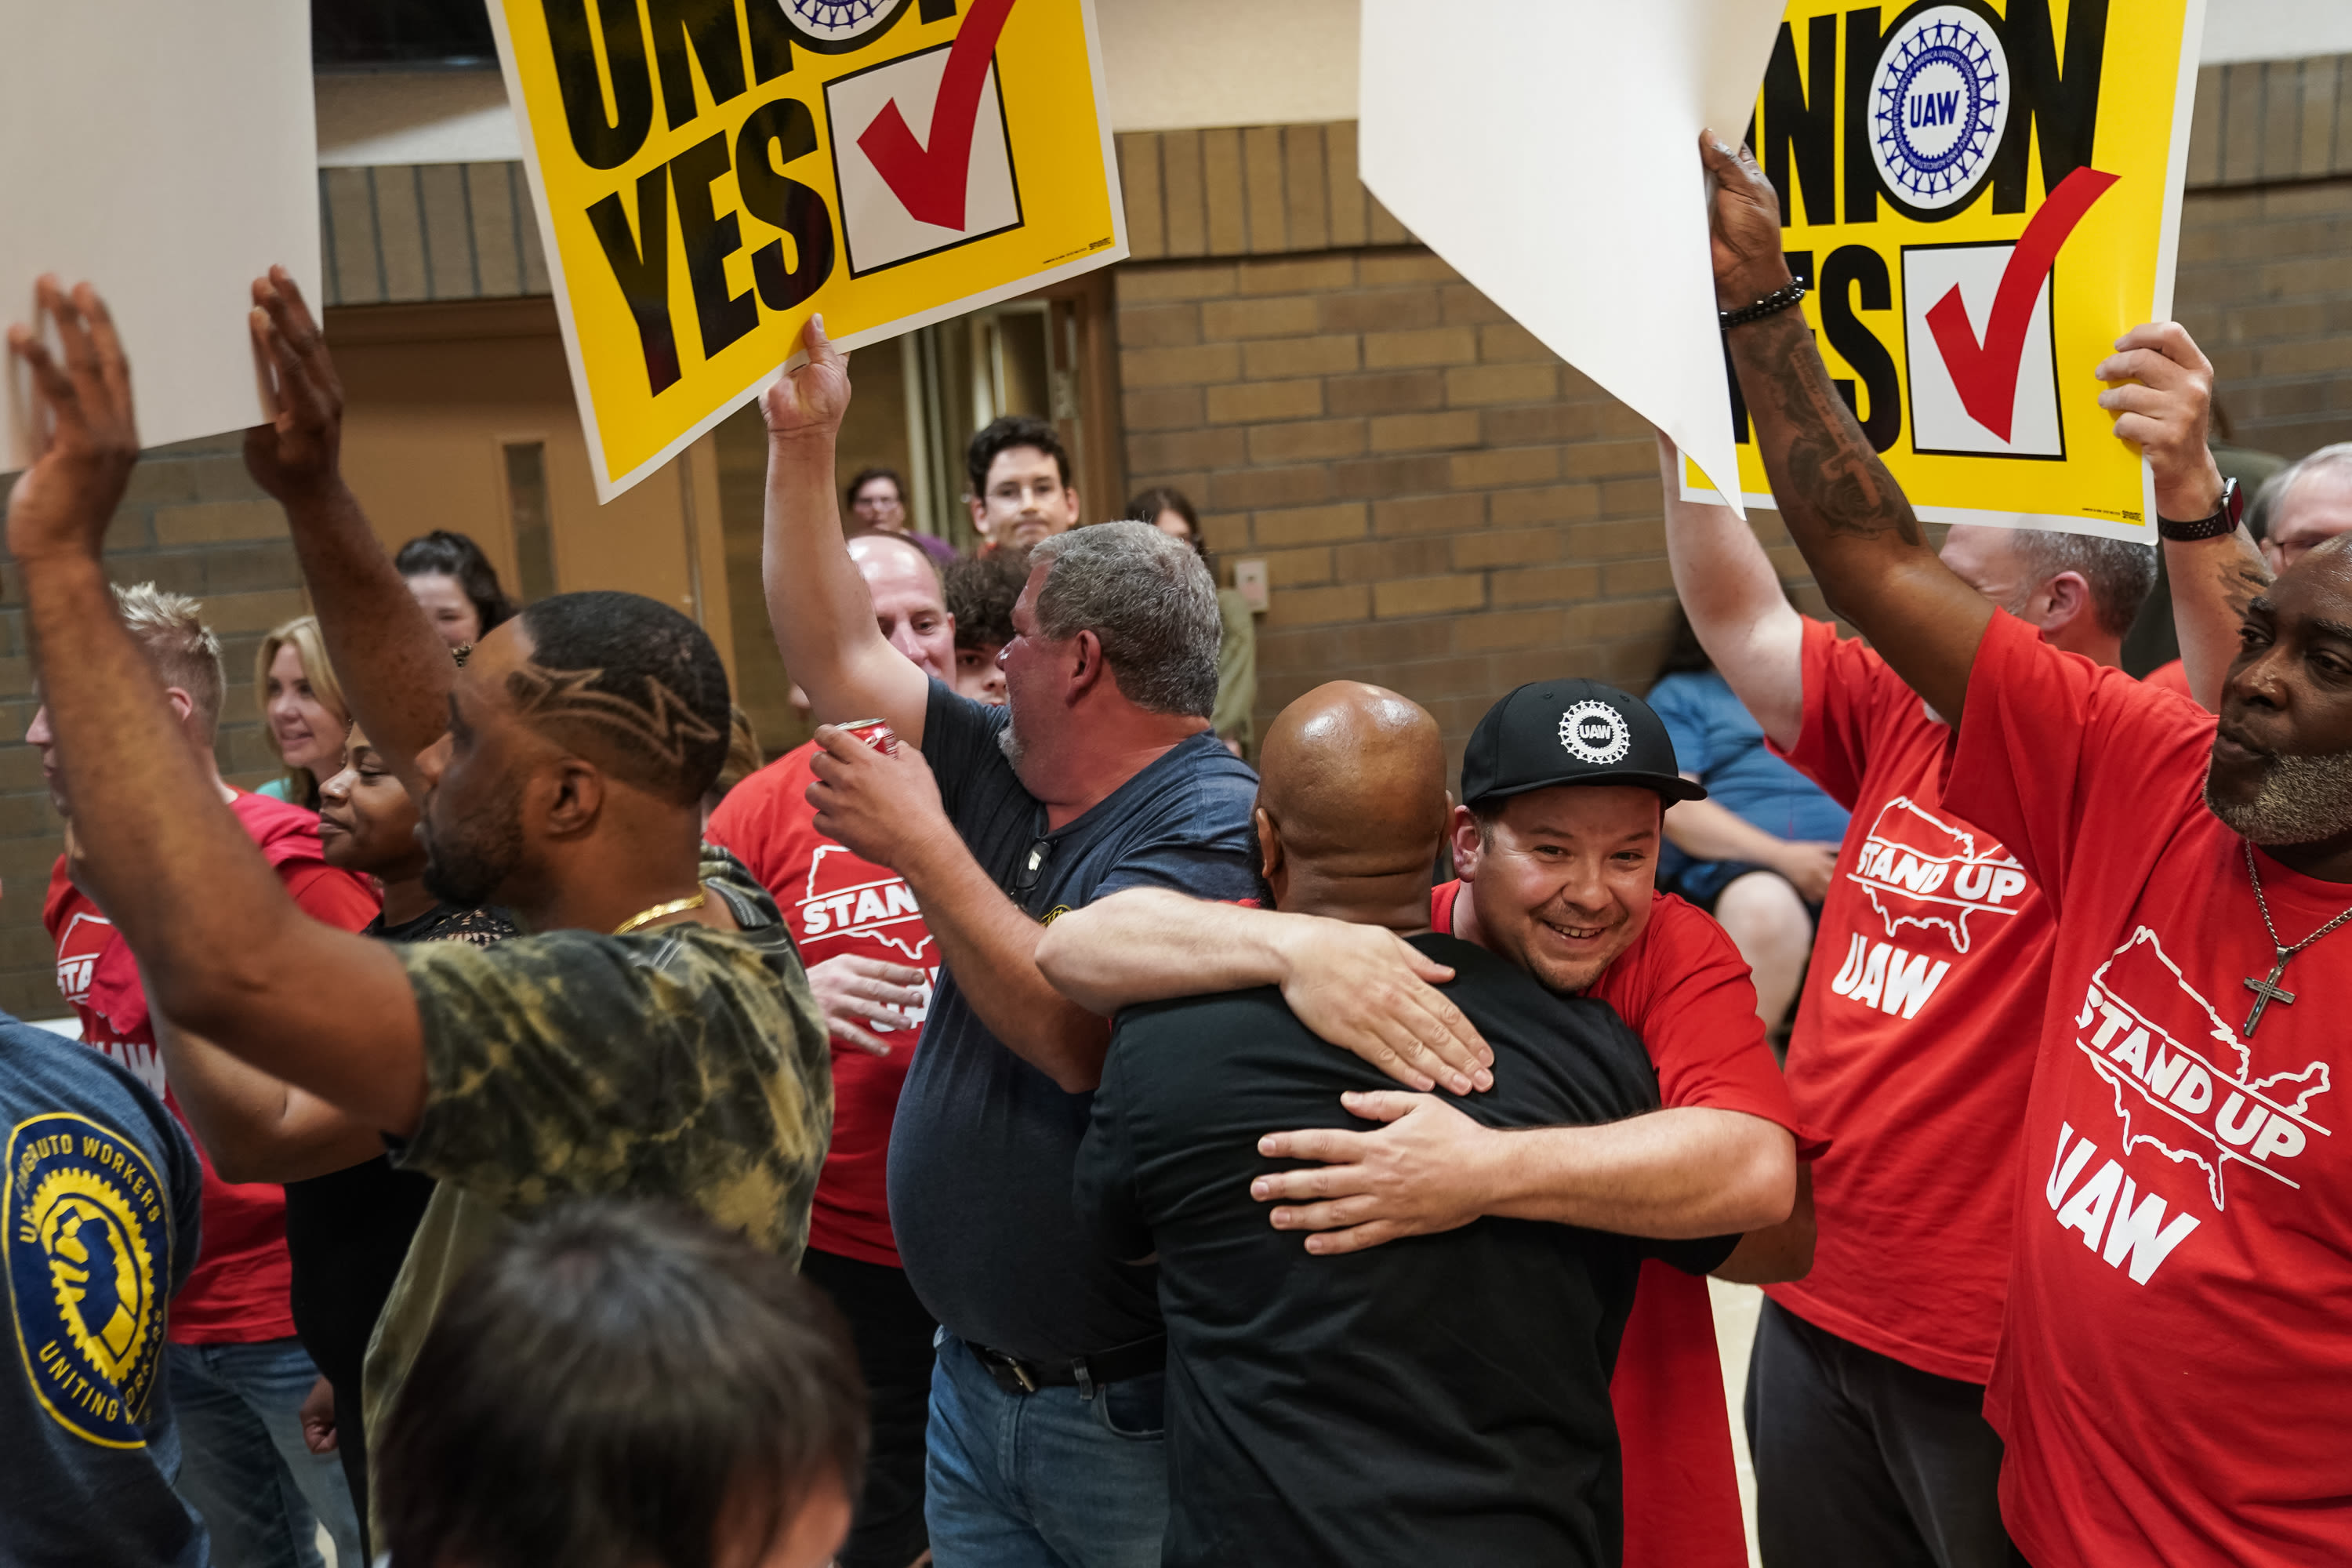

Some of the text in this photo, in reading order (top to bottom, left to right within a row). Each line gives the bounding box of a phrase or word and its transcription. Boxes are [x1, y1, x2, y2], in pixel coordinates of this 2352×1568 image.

[1913, 49, 1938, 70] AMERICA
[1740, 0, 2109, 227] NION
[1911, 90, 1960, 129] UAW
[586, 98, 835, 397] YES
[1579, 724, 1611, 739] UAW
[803, 884, 920, 935] STAN
[1857, 843, 2027, 904] STAND UP
[57, 960, 93, 995] STA
[1831, 932, 1951, 1020] UAW
[2075, 984, 2307, 1161] STAND UP
[82, 1135, 161, 1223] WORKERS
[2046, 1121, 2201, 1286] UAW
[39, 1339, 118, 1423] UNITING
